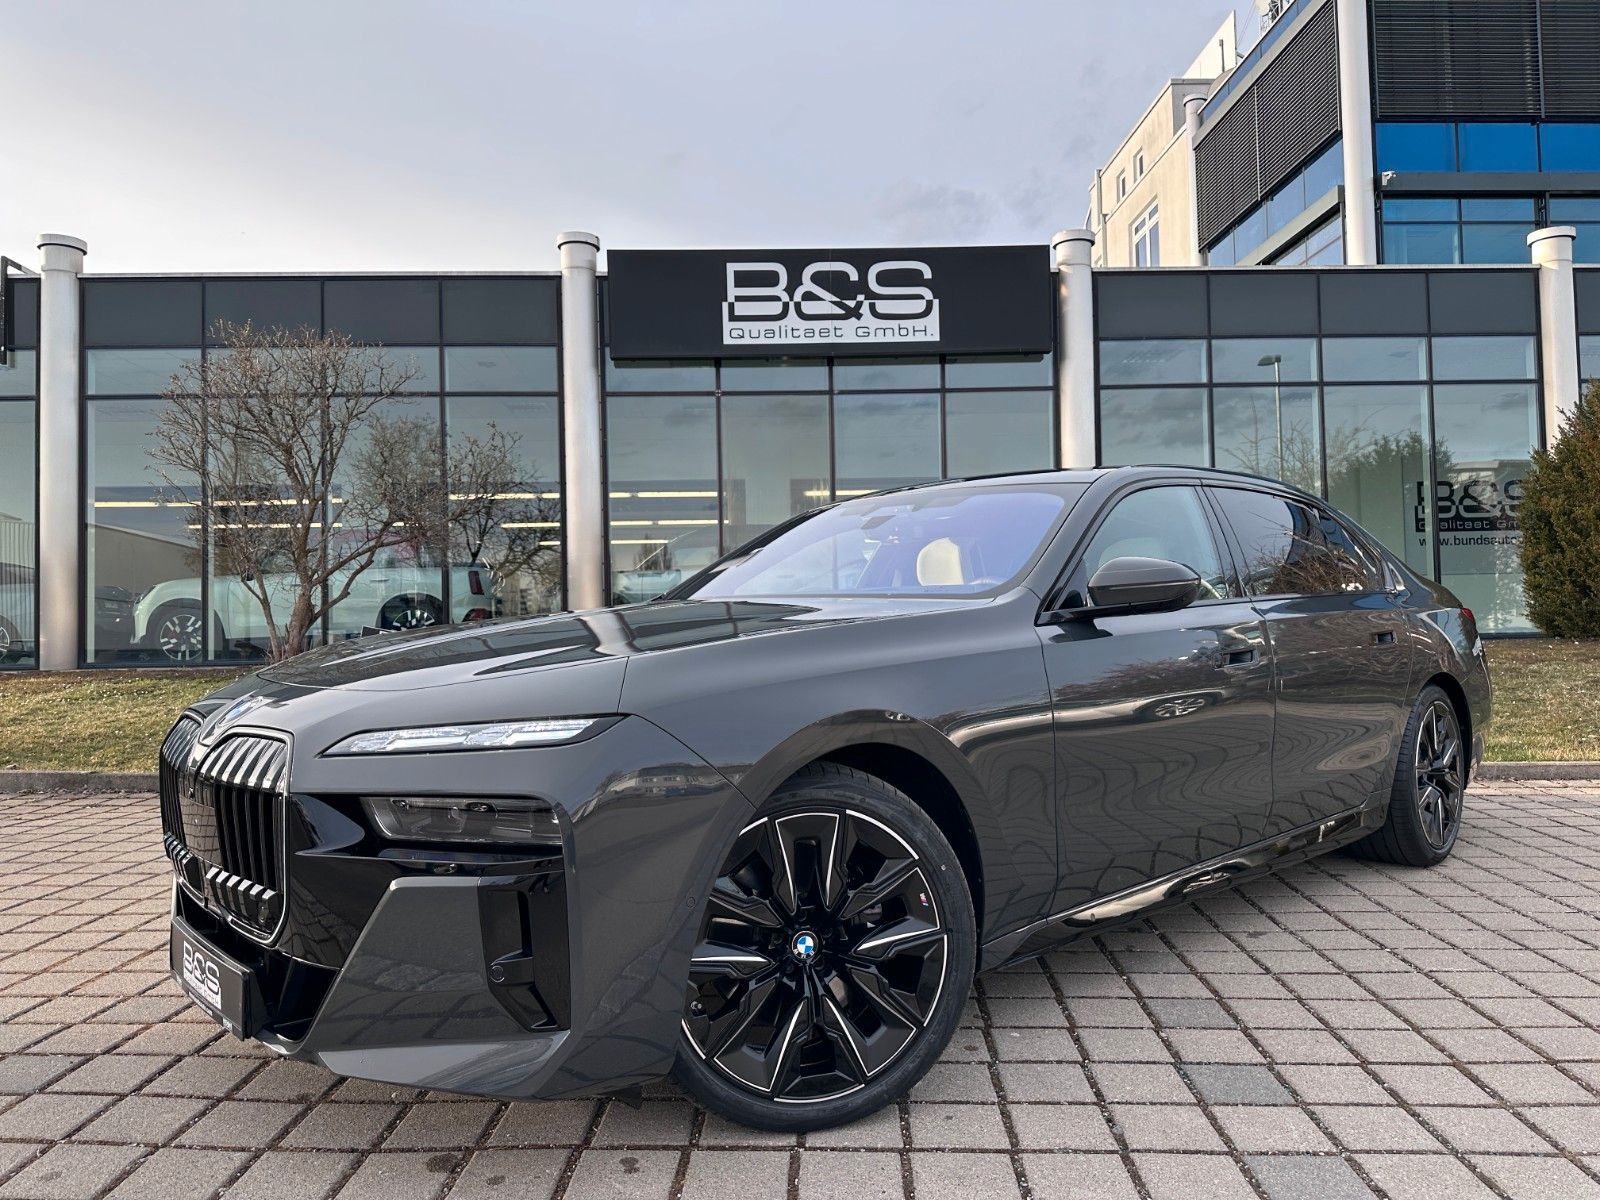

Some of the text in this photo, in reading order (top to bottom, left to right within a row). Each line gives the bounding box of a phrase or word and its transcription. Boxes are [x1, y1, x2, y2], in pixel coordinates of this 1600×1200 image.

[726, 260, 934, 322] B&S
[729, 323, 934, 340] Qualitaet GmbH.
[1418, 520, 1490, 530] Qalitaet
[184, 940, 220, 996] B&S
